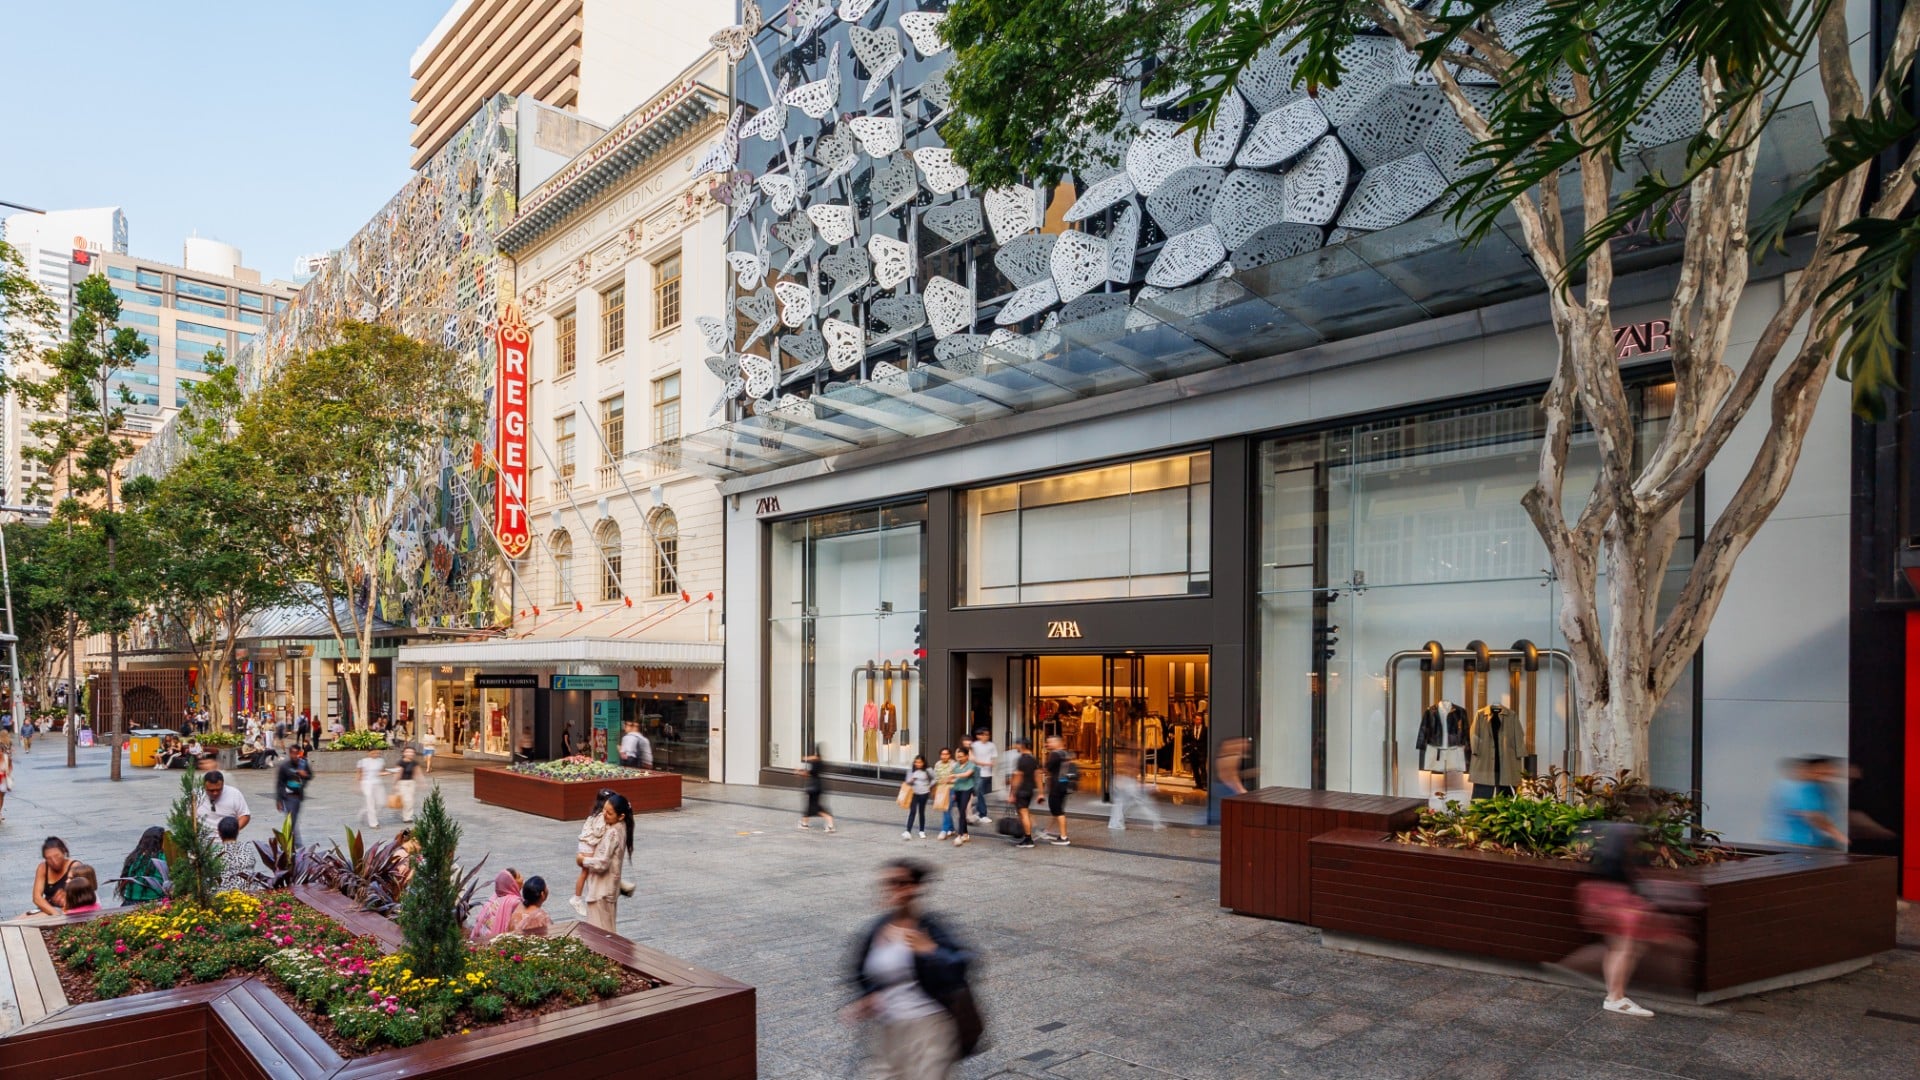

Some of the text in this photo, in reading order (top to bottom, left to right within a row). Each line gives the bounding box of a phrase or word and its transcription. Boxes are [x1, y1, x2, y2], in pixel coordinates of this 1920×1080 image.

[506, 348, 524, 528] REGENT
[756, 496, 782, 514] ZARA
[1047, 620, 1083, 638] ZARA
